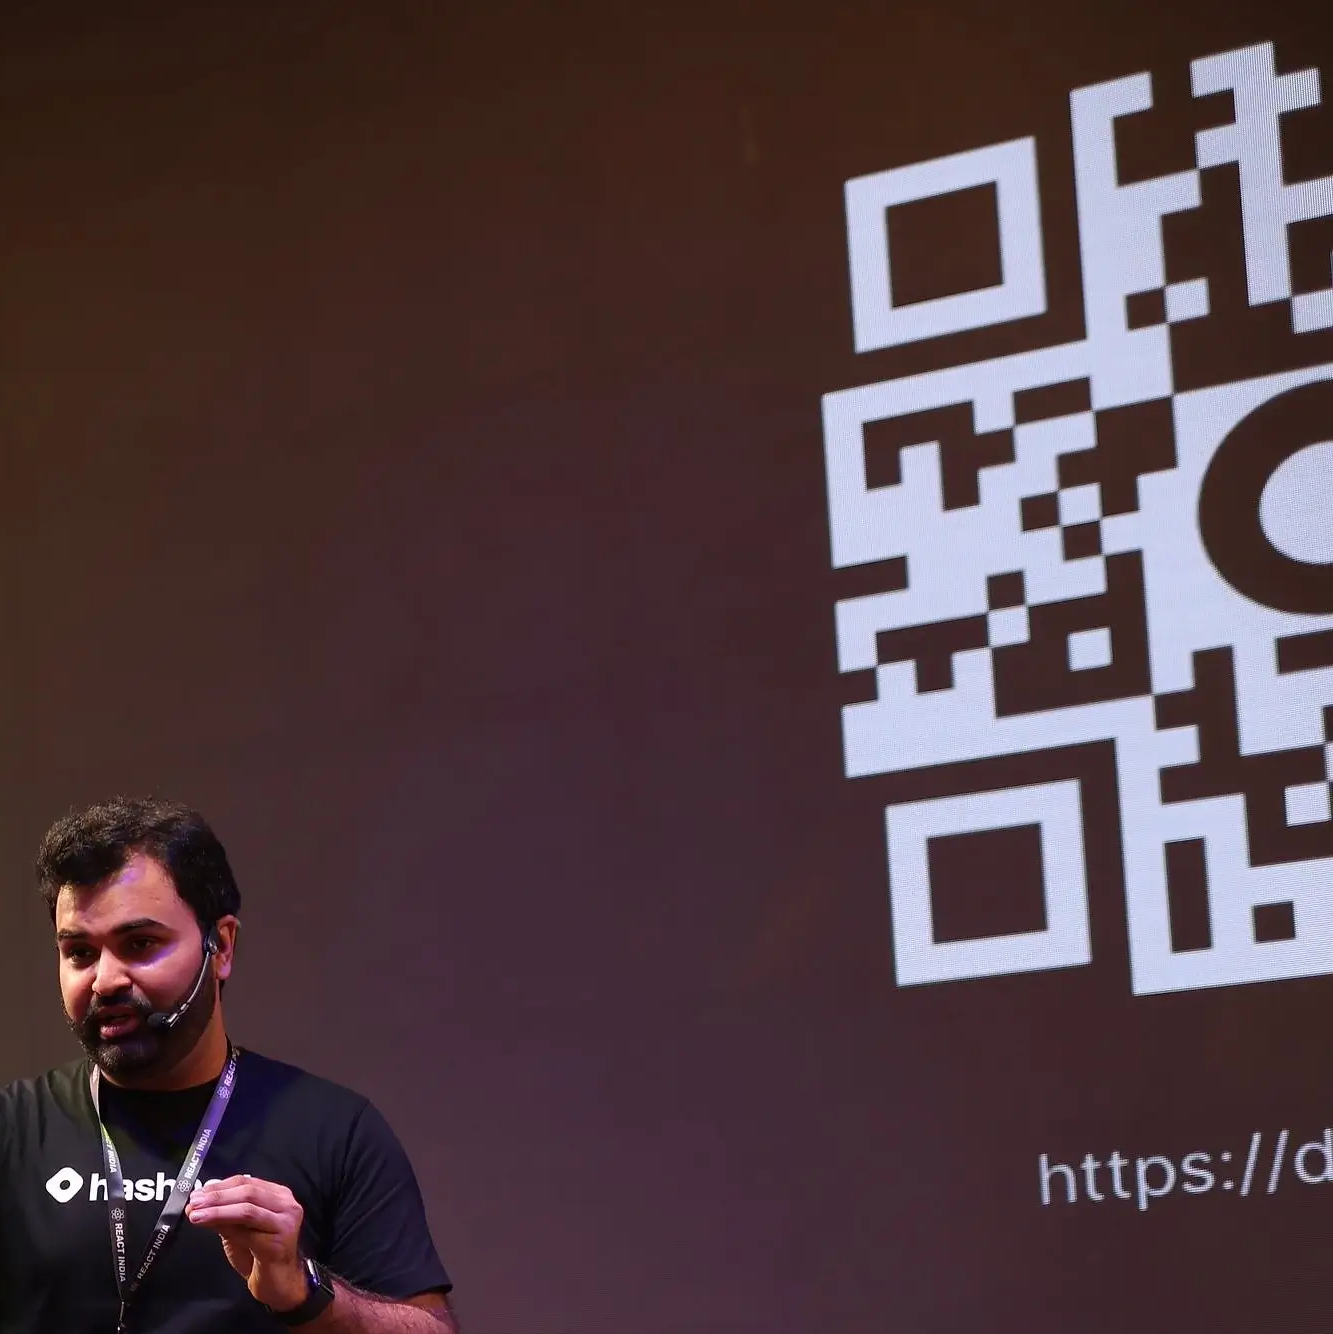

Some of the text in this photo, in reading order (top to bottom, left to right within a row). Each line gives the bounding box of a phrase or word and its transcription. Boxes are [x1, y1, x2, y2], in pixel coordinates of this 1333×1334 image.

[185, 1128, 212, 1179] REACT INDIA
[1039, 1128, 1333, 1211] https://d
[114, 1222, 127, 1282] REACT INDIA
[136, 1223, 171, 1280] REACT INDIA
